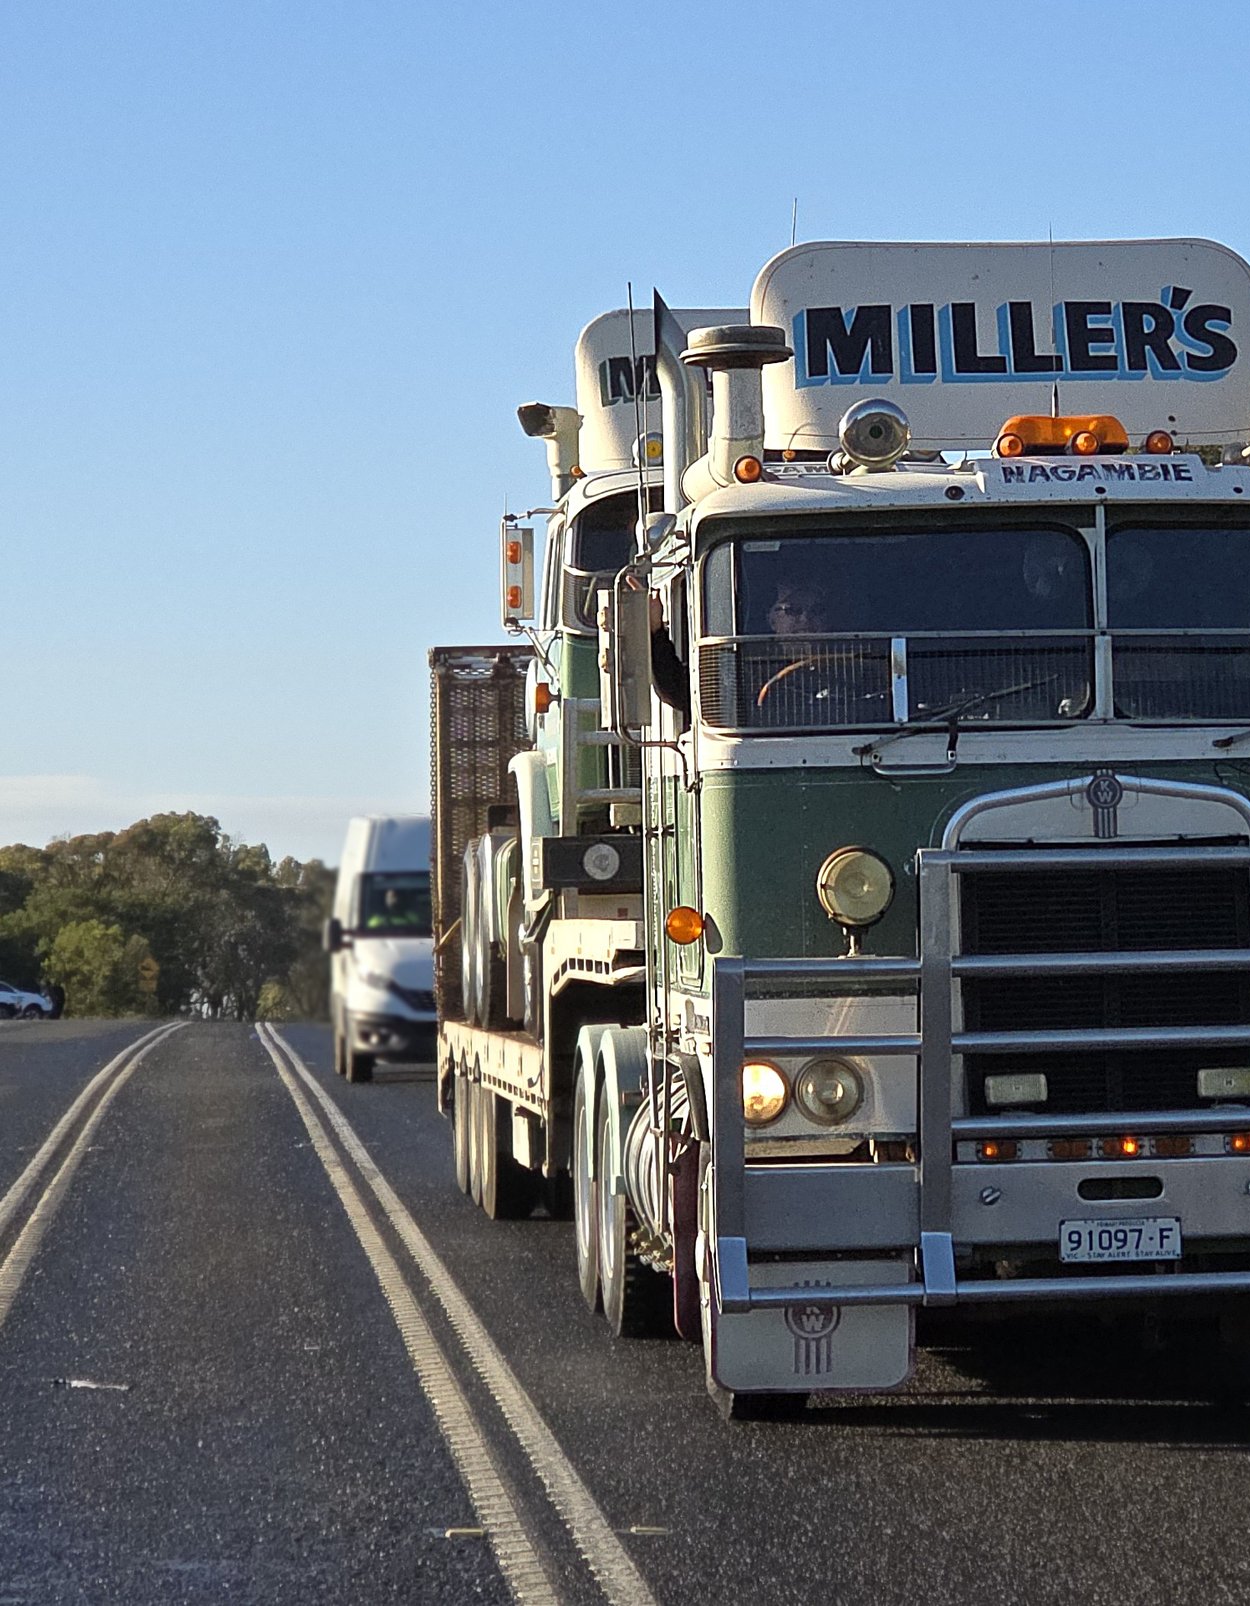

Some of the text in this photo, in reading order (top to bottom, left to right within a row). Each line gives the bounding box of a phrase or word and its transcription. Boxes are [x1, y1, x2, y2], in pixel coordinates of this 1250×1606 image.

[795, 285, 1238, 386] MILLER'S
[1001, 463, 1194, 483] NAGAMBIE
[1087, 1251, 1105, 1259] STAY
[1107, 1251, 1131, 1259] ALERT
[1135, 1250, 1153, 1258] STAY
